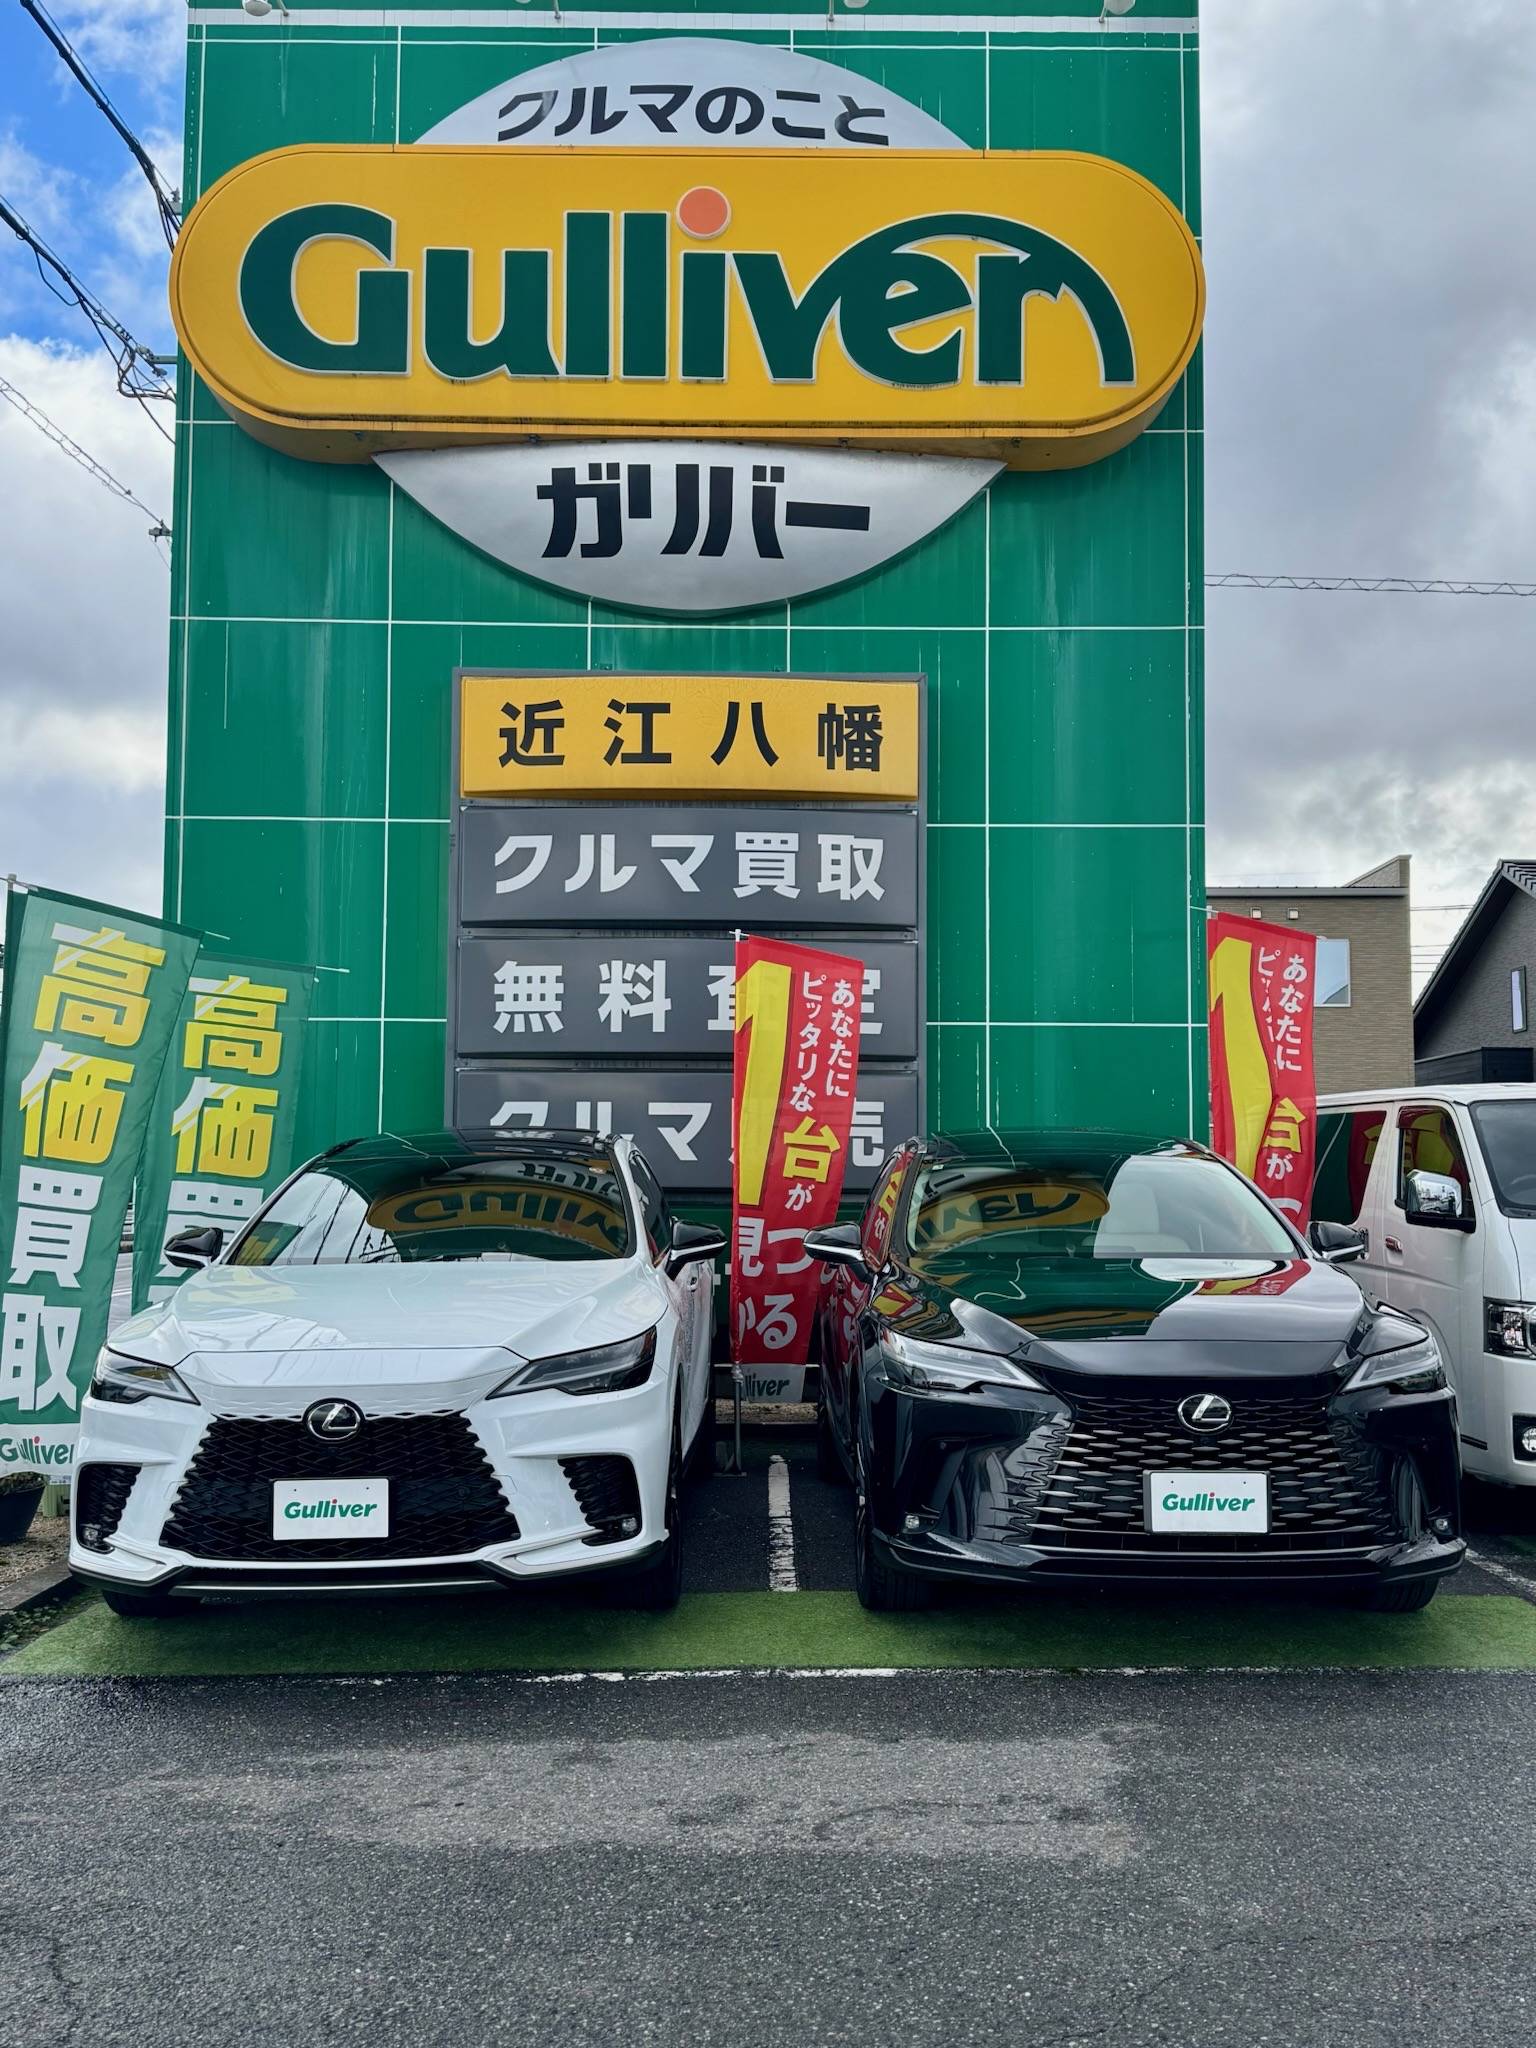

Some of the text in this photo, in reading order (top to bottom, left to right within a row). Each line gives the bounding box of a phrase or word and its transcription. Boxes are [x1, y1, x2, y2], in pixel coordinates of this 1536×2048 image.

[498, 84, 889, 146] クルマのこと
[239, 187, 1136, 388] Gulliver
[537, 461, 870, 561] ガリバー
[498, 699, 884, 772] 近江八幡
[494, 832, 885, 901] クルマ買取
[826, 979, 855, 1097] あなたに
[1277, 954, 1307, 1071] あなたに
[0, 922, 165, 1413] 高価買取
[150, 975, 287, 1310] 高価買
[744, 1371, 791, 1398] lliver
[284, 1498, 378, 1519] Gulliver
[1162, 1492, 1256, 1511] Gulliver
